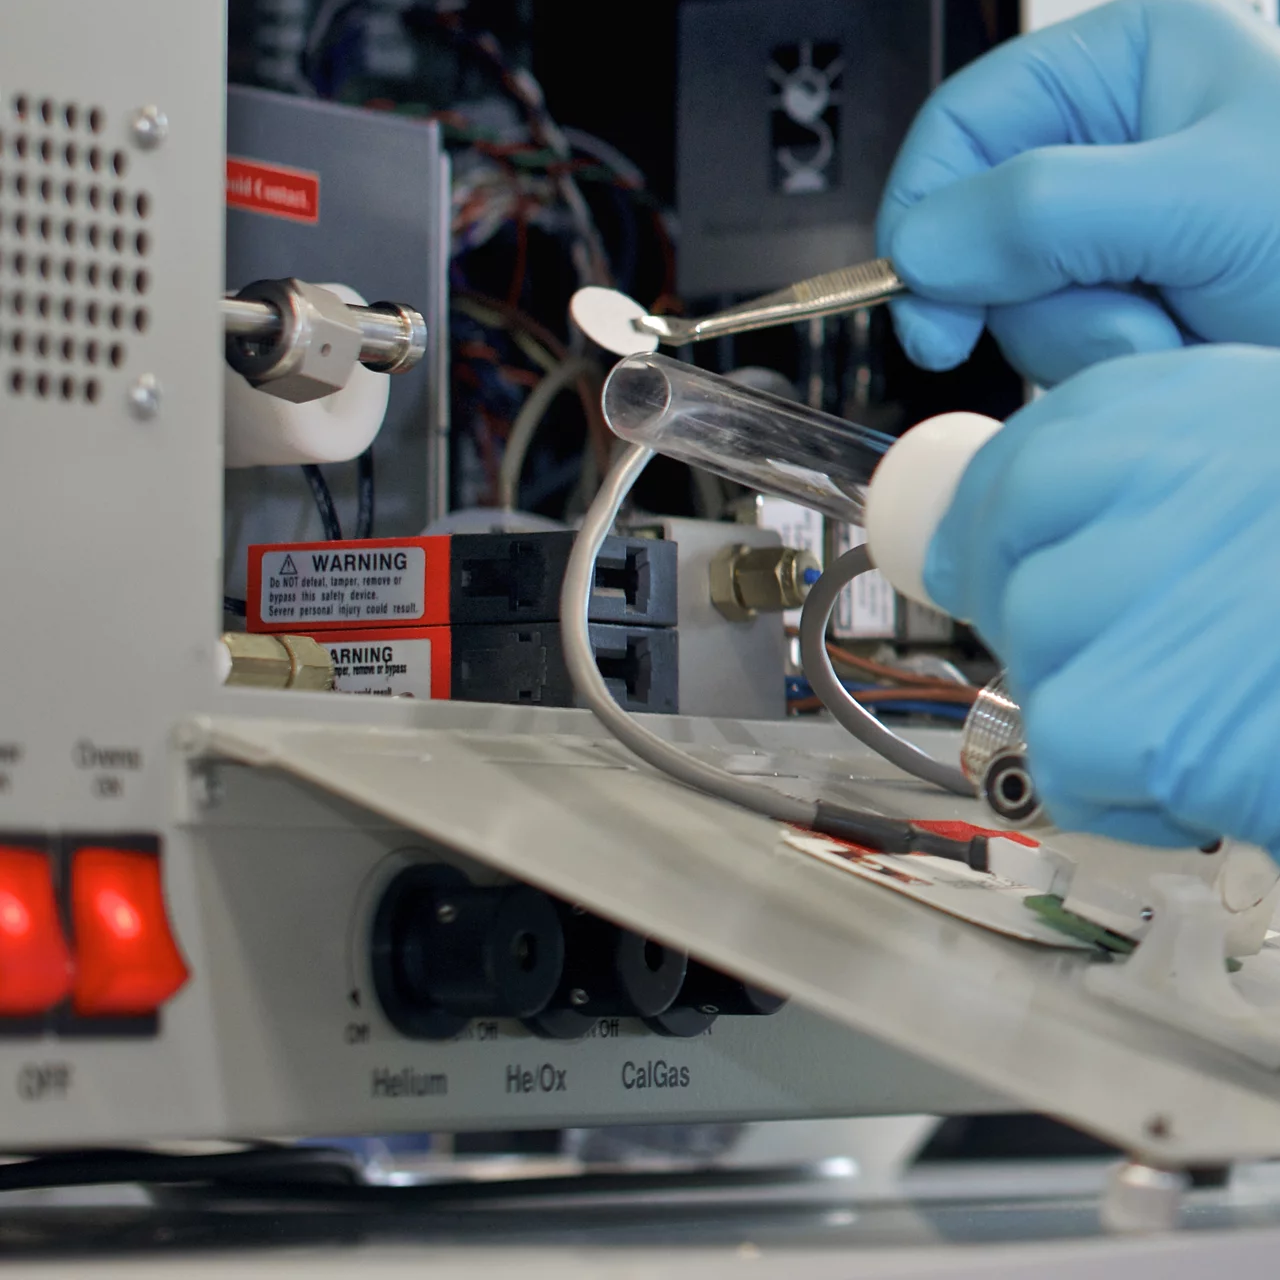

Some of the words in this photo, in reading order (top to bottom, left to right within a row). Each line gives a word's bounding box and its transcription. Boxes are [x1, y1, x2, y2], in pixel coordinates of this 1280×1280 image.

[312, 553, 407, 572] WARNING
[269, 577, 280, 588] Do
[283, 577, 298, 588] NOT
[301, 577, 328, 588] defeat,
[331, 576, 360, 588] tamper,
[363, 576, 391, 586] remove
[394, 576, 402, 585] or
[269, 592, 296, 604] bypass
[302, 591, 316, 601] this
[321, 590, 345, 603] safety
[350, 590, 379, 600] device.
[268, 605, 295, 617] Severe
[300, 605, 334, 618] personal
[339, 604, 361, 618] injury
[366, 603, 388, 614] could
[393, 603, 419, 614] result.
[330, 647, 393, 665] ARNING
[353, 665, 375, 675] remove
[377, 665, 384, 674] or
[385, 664, 407, 676] bypass
[600, 1019, 619, 1038] Off
[372, 1065, 447, 1098] Helium
[506, 1063, 567, 1094] He/Ox
[622, 1060, 690, 1089] CalGas
